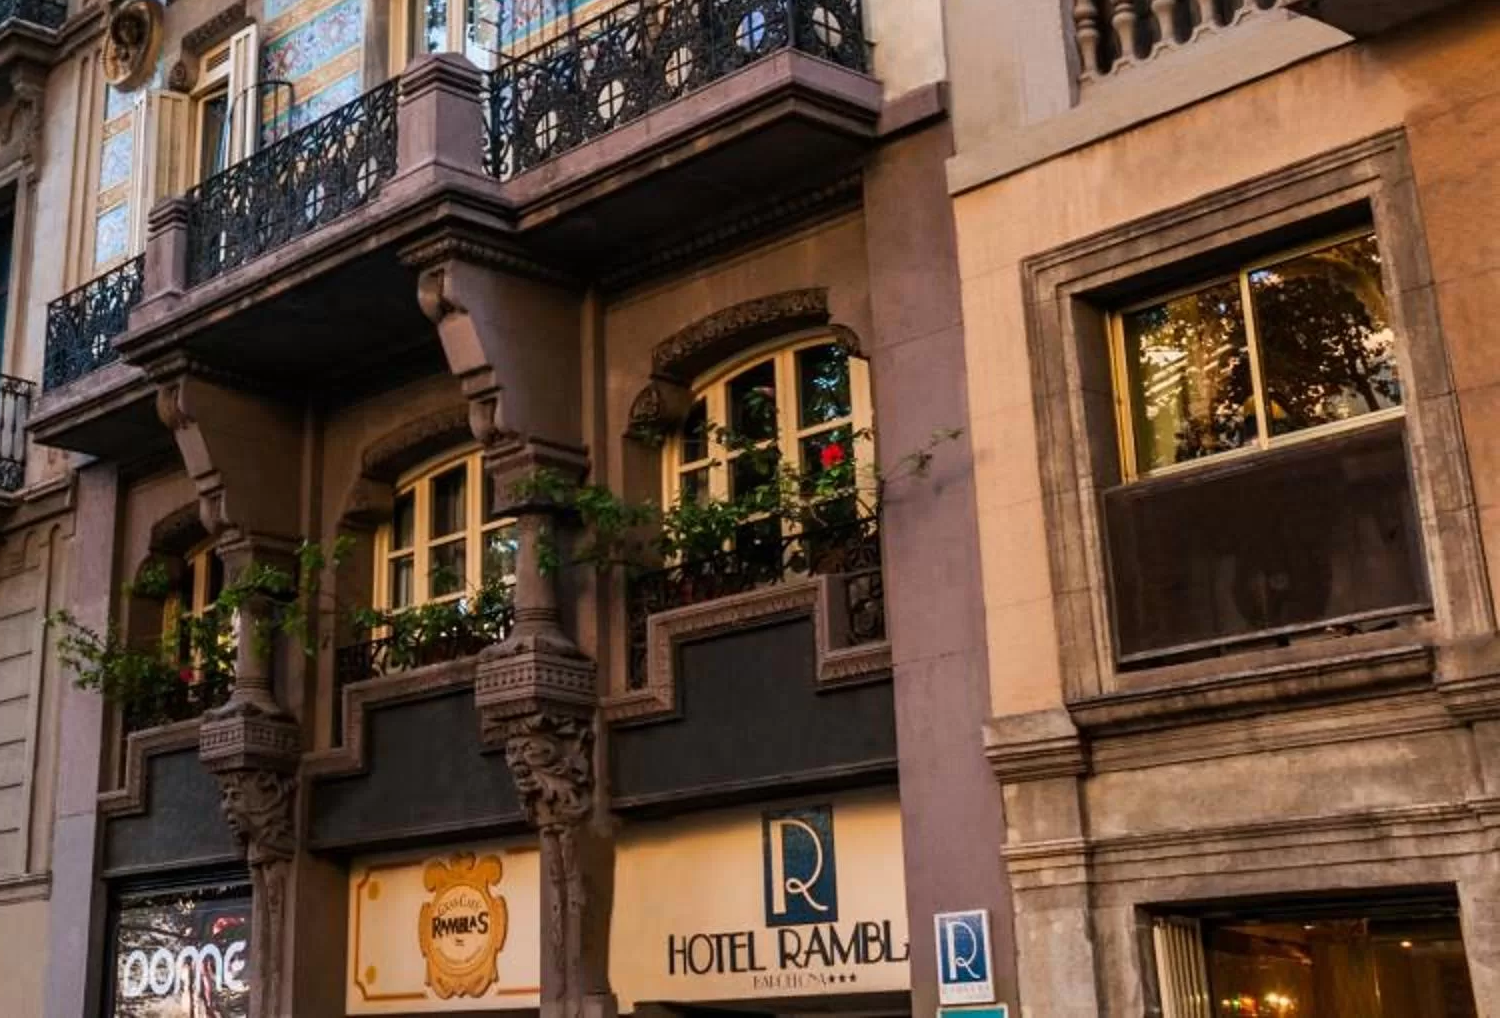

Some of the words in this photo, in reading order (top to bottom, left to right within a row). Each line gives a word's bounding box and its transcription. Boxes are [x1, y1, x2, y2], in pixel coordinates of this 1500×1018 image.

[770, 818, 829, 914] R
[668, 930, 767, 976] HOTEL
[946, 919, 981, 980] R
